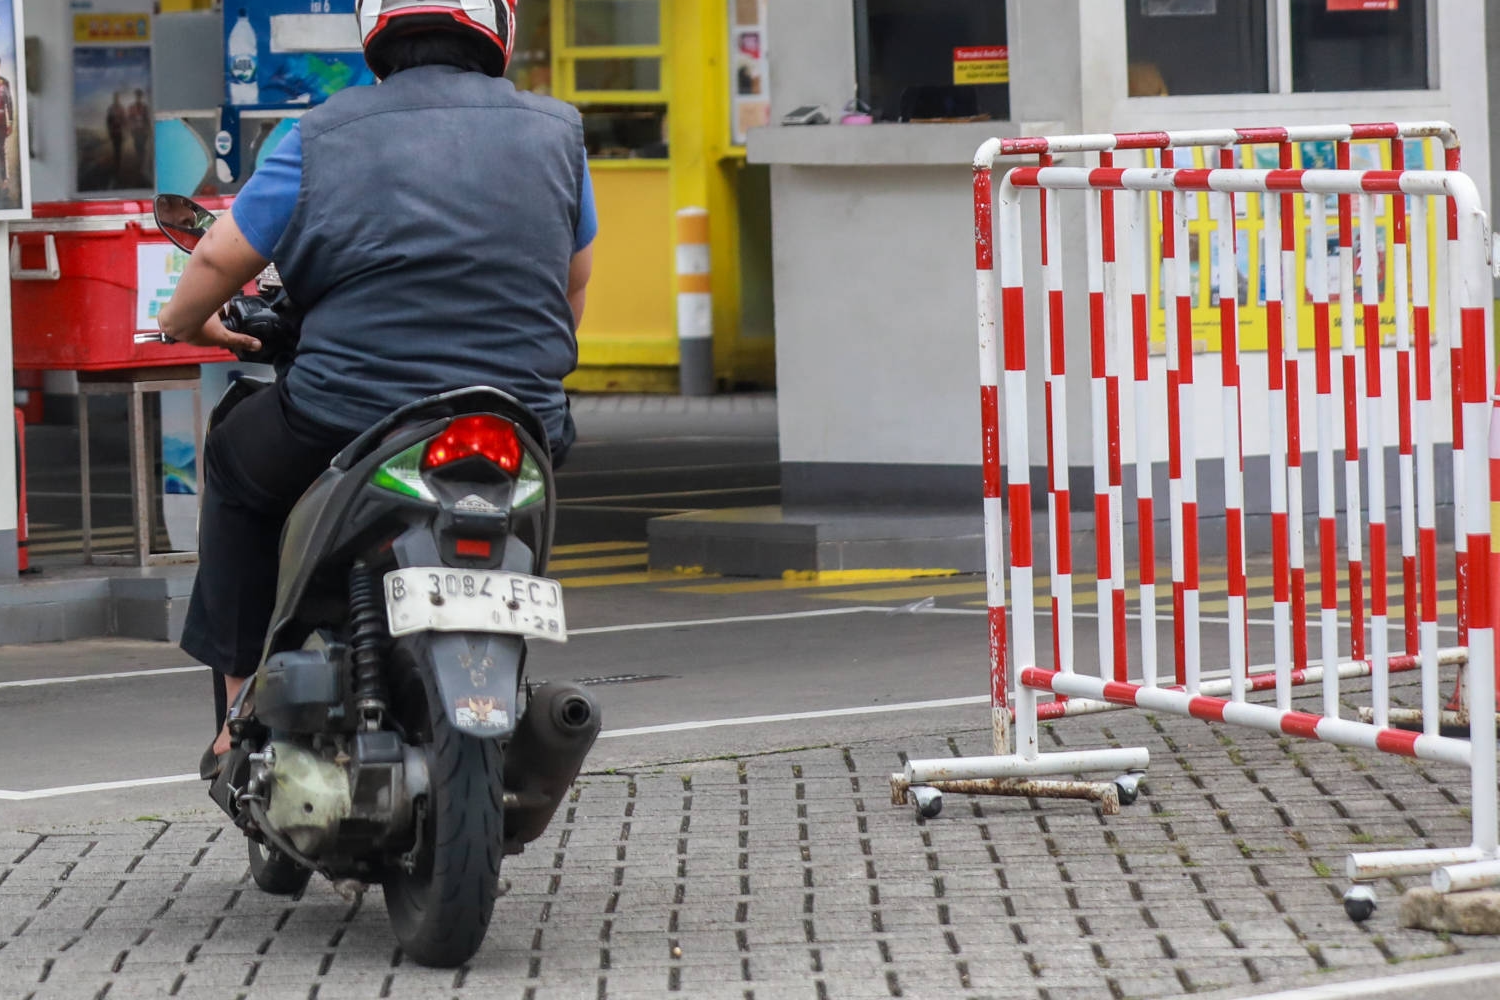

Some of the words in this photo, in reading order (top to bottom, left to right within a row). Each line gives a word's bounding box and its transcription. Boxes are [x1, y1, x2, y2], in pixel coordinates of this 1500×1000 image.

[311, 0, 322, 12] isi
[323, 0, 331, 12] 6
[392, 576, 405, 600] B
